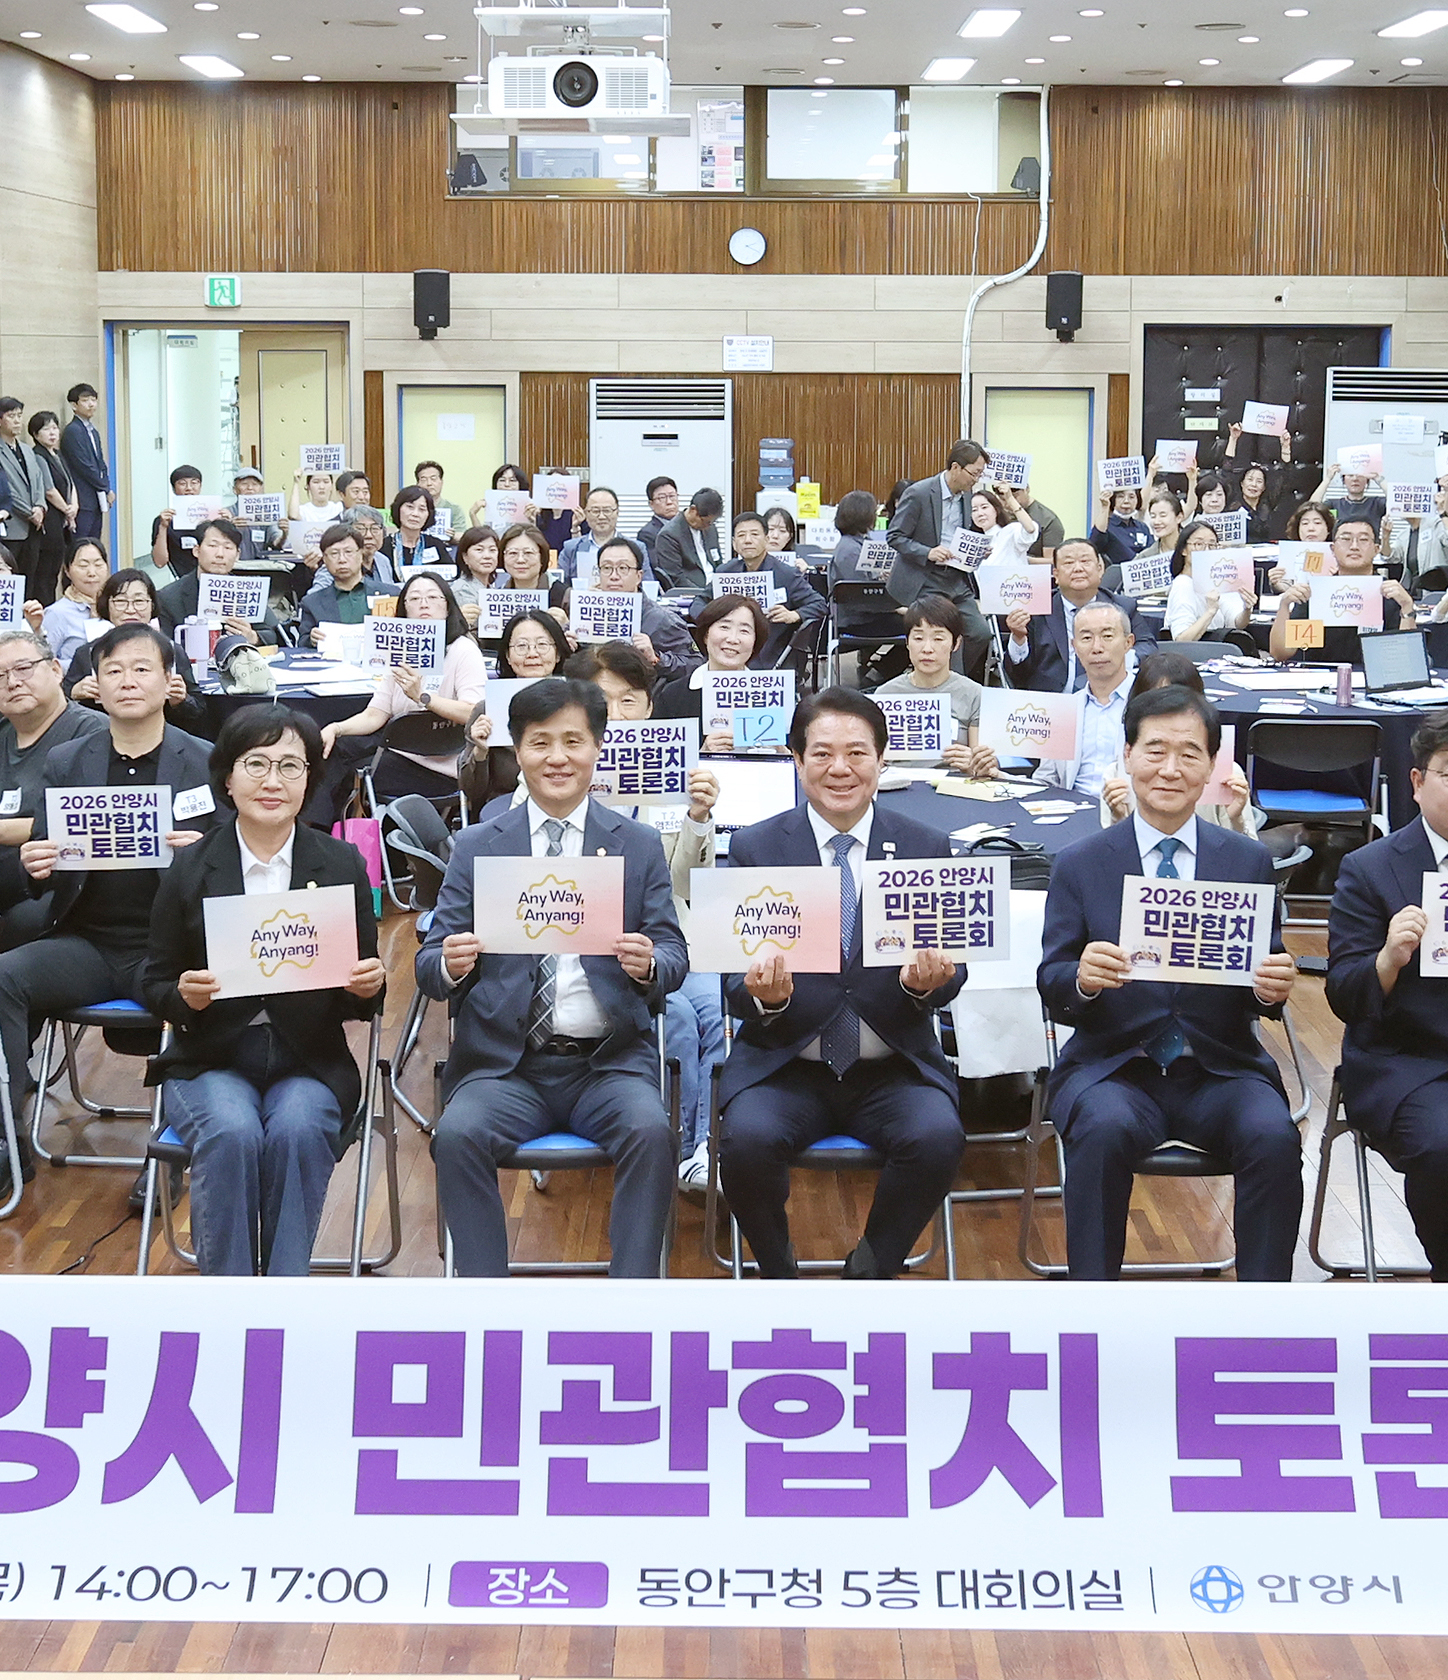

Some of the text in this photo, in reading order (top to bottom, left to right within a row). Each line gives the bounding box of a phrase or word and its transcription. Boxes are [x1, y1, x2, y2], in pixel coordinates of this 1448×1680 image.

[1105, 467, 1140, 479] 민관협치
[1115, 477, 1140, 487] 토론회
[1395, 493, 1431, 503] 민관협치
[1403, 504, 1431, 513] 토론회
[960, 533, 980, 544] 2026
[1127, 563, 1148, 572] 2026
[208, 579, 262, 590] 2026 안양시
[743, 575, 767, 585] 안양시
[210, 589, 261, 604] 민관협치
[486, 594, 540, 603] 2026 안양시
[578, 595, 634, 606] 2026 안양시
[221, 604, 259, 618] 토론회
[581, 607, 633, 622] 민관협치
[373, 622, 436, 635] 2026 안양시
[593, 623, 632, 637] 토론회
[1291, 624, 1317, 644] T4
[376, 634, 435, 652] 민관협치
[390, 652, 434, 668] 토론회
[712, 676, 784, 688] 2026 안양시
[716, 690, 784, 708] 민관협치
[905, 700, 940, 712] 안양시
[736, 714, 778, 742] T2
[1007, 713, 1051, 726] Any Way,
[641, 726, 685, 743] 안양시
[1011, 725, 1050, 738] Anyang!
[889, 734, 941, 750] 토론회
[617, 771, 685, 795] 토론회
[60, 793, 158, 810] 2026 안양시
[66, 810, 159, 836] 민관협치
[91, 834, 159, 859] 토론회
[878, 866, 993, 888] 2026 안양시
[518, 890, 585, 908] Any Way,
[885, 890, 993, 921] 민관협치
[1140, 887, 1257, 911] 2026 안양시
[524, 909, 584, 925] Anyang!
[735, 902, 801, 921] Any Way,
[741, 923, 801, 939] Anyang!
[1144, 909, 1254, 941] 민관협치
[251, 924, 317, 944] Any Way,
[912, 921, 994, 949] 토론회
[258, 943, 319, 960] Anyang!
[1168, 941, 1252, 972] 토론회
[352, 1328, 1104, 1518] 민관협치
[50, 1565, 388, 1604] 14:00~17:00
[487, 1566, 569, 1604] 장소
[637, 1567, 1124, 1611] 동안구청 5층 대회의실
[1257, 1574, 1403, 1605] 안양시
